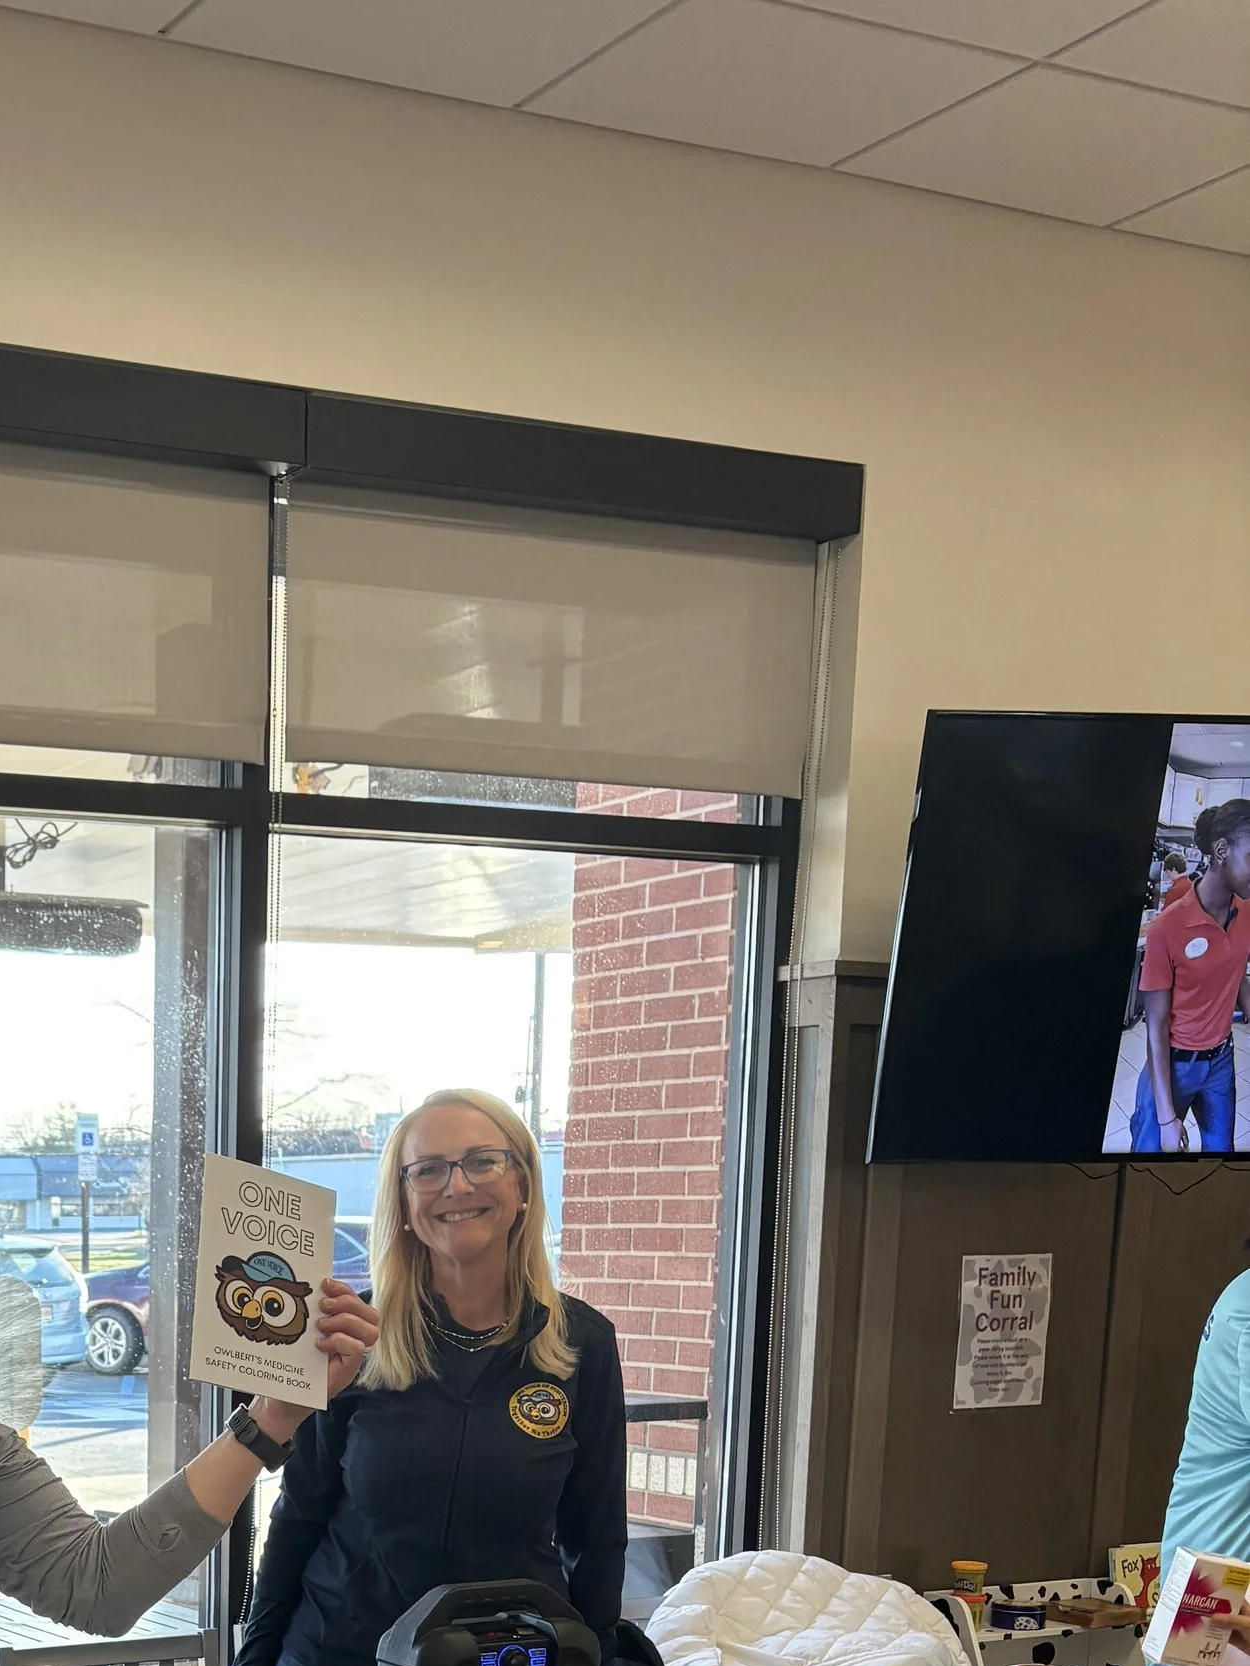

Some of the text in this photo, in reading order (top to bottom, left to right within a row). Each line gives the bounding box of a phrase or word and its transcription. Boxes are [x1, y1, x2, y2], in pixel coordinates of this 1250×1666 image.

[239, 1181, 301, 1221] ONE
[221, 1207, 315, 1257] VOICE
[978, 1266, 1037, 1291] Family
[990, 1290, 1022, 1309] Fun
[975, 1311, 1034, 1332] Corral
[205, 1357, 237, 1371] SAFETY
[239, 1365, 284, 1384] COLORING
[214, 1346, 305, 1376] OWLBERT'S MEDICINE
[1121, 1559, 1140, 1578] Fox
[1181, 1593, 1218, 1610] NARCAN
